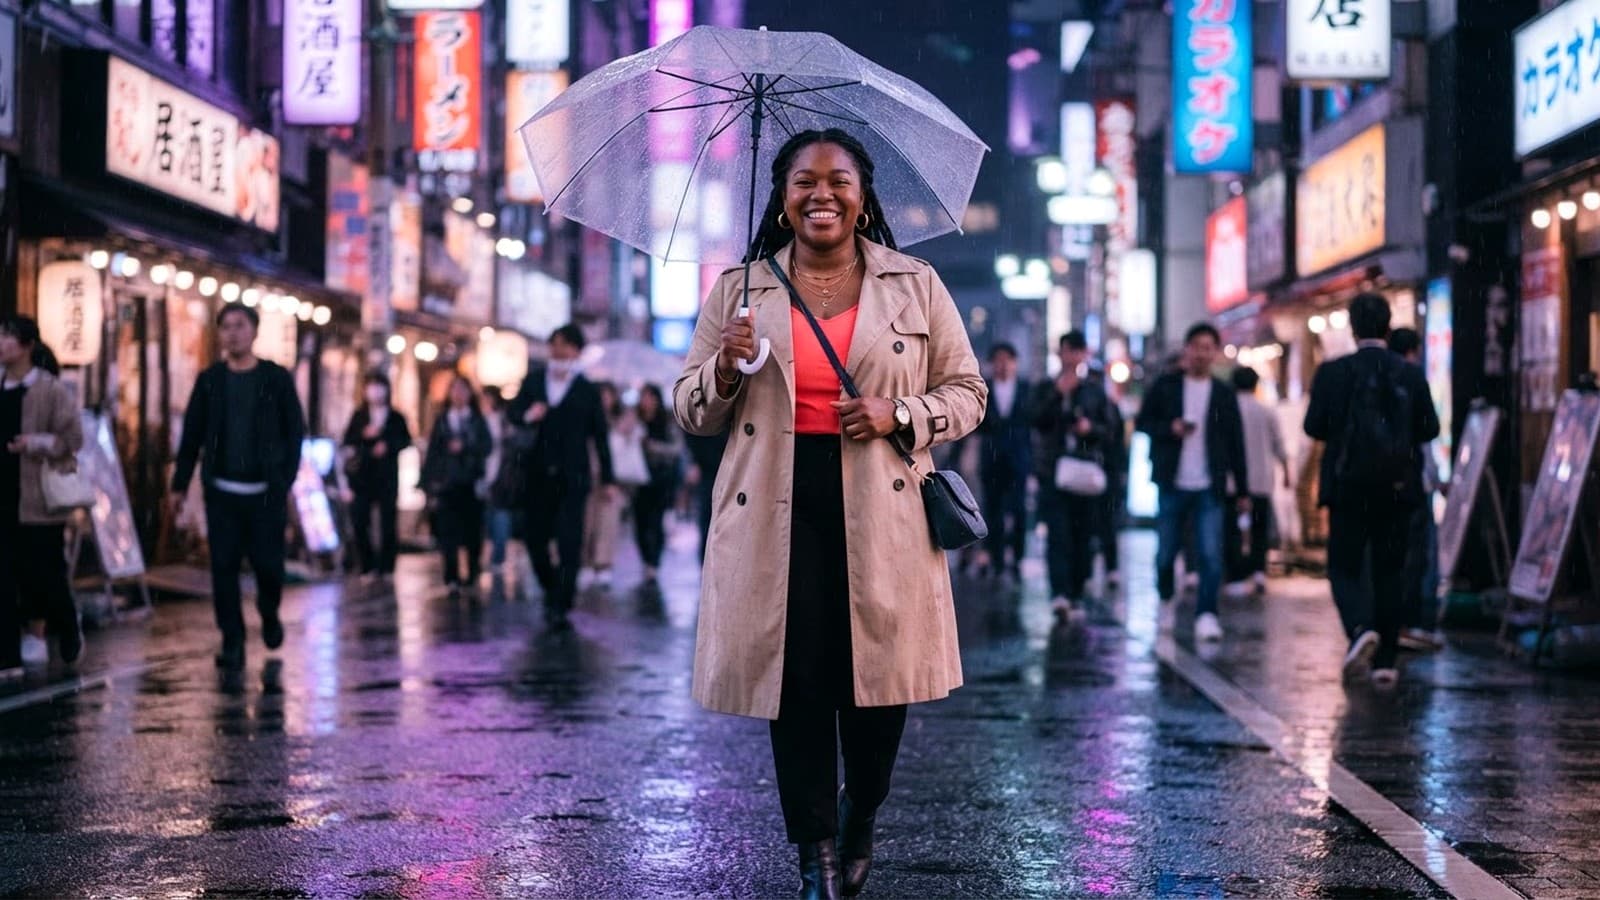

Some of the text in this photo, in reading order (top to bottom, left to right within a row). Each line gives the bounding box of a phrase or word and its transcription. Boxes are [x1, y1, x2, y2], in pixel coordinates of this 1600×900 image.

[296, 0, 341, 98] 酒屋
[426, 14, 471, 146] ラーメン
[153, 102, 226, 194] 居酒屋
